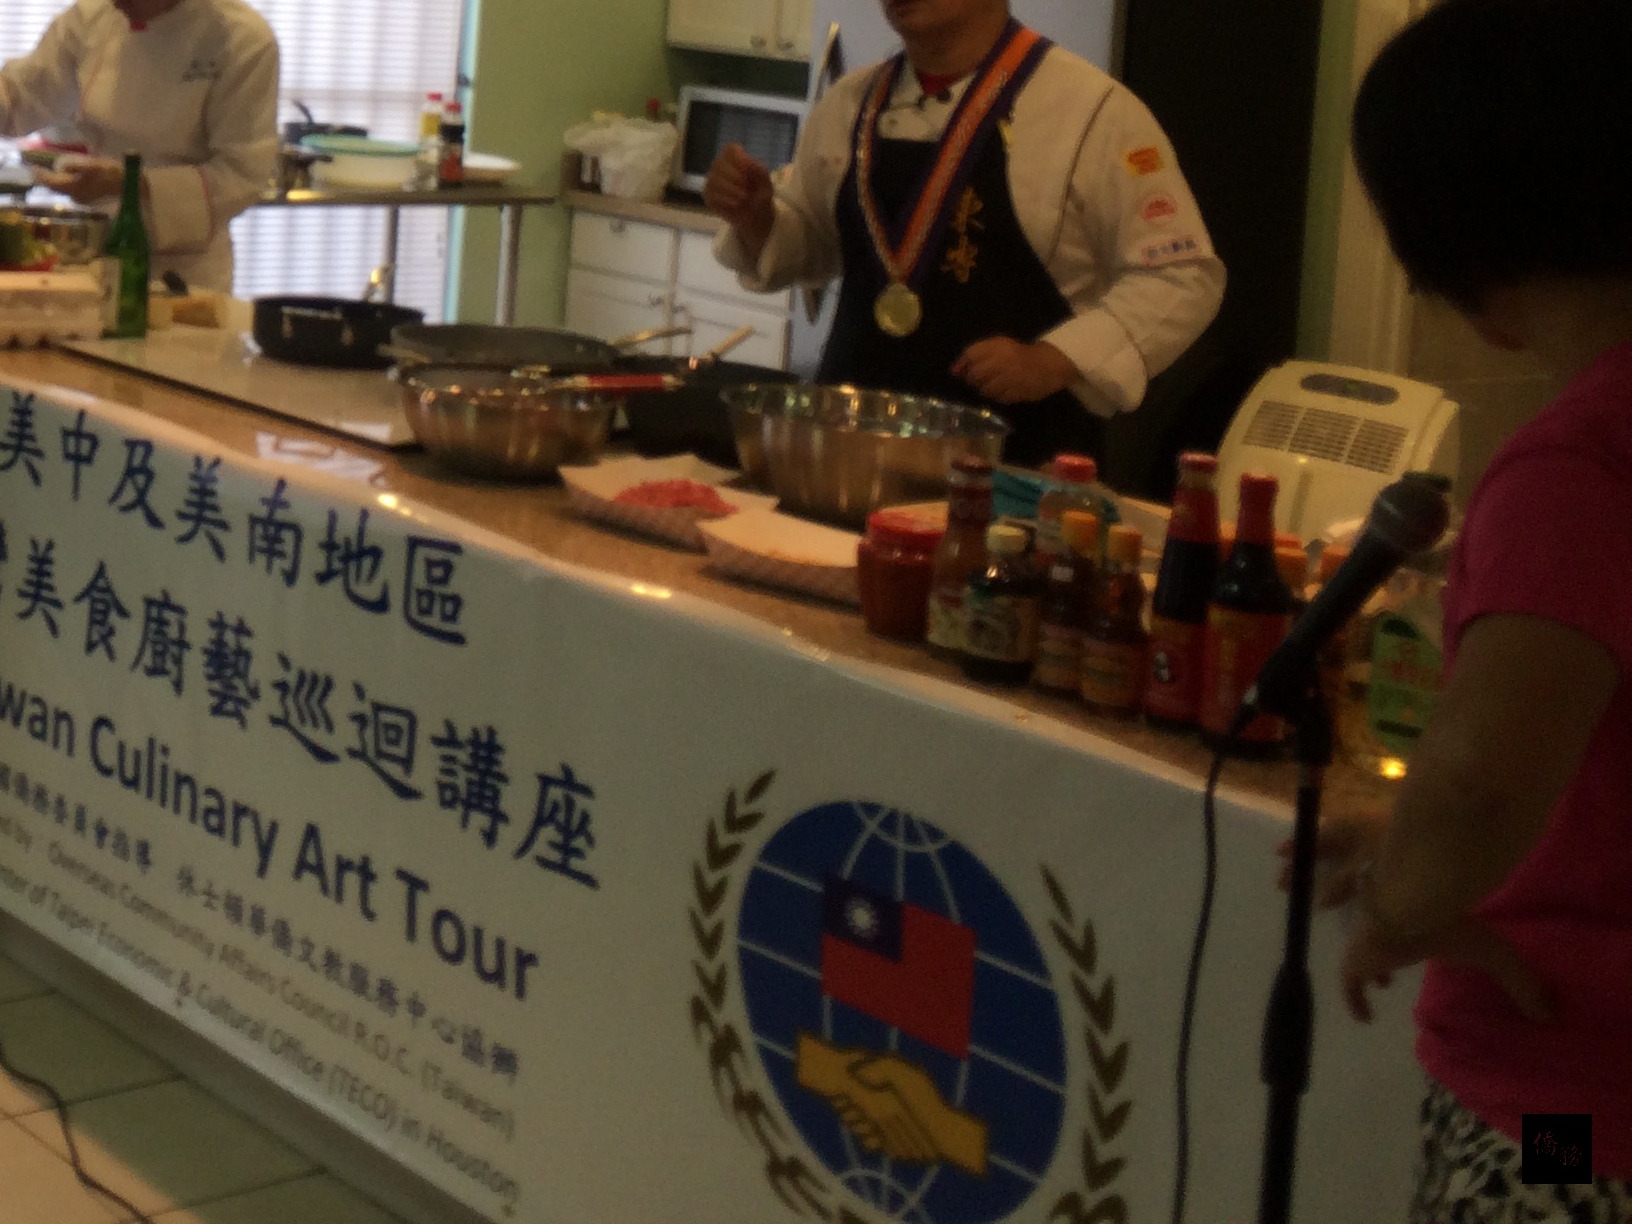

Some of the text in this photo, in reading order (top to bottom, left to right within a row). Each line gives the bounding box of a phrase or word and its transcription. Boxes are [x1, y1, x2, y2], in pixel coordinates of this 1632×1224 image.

[88, 720, 279, 880] Culinary
[293, 820, 377, 923] Art
[394, 868, 541, 1001] Tour
[279, 975, 349, 1038] Council
